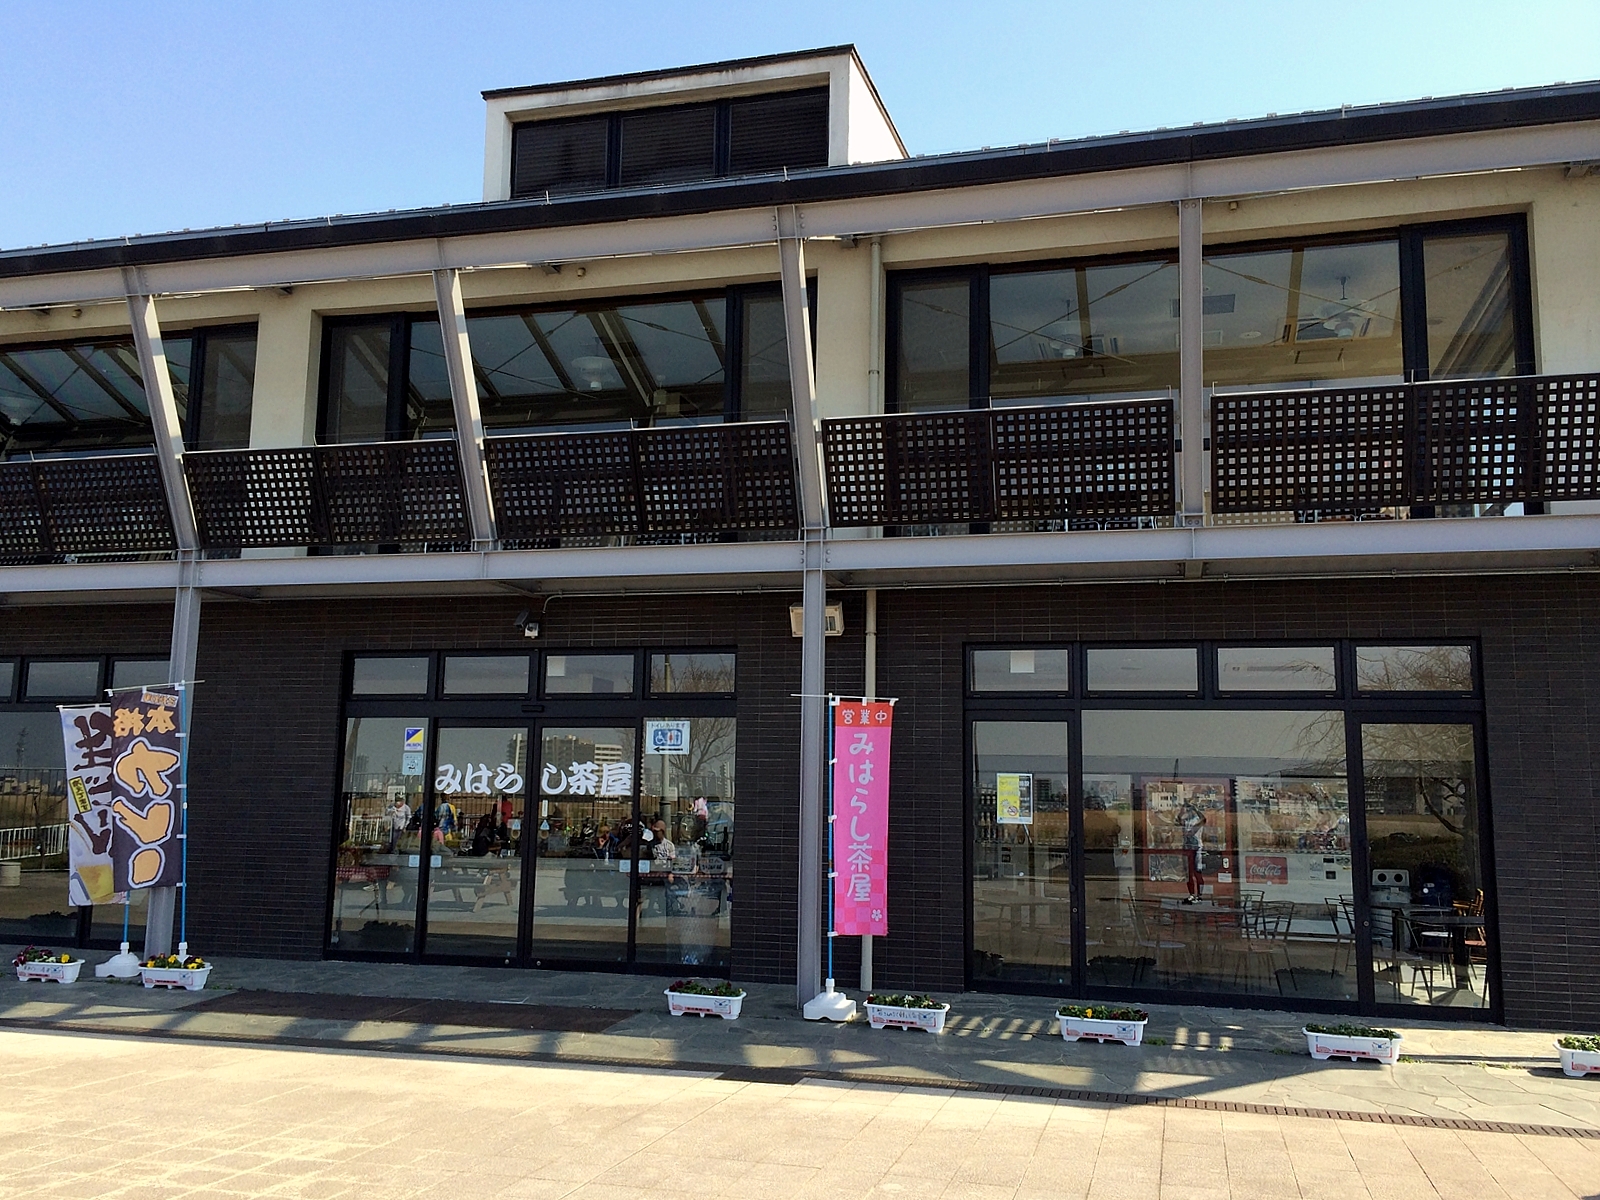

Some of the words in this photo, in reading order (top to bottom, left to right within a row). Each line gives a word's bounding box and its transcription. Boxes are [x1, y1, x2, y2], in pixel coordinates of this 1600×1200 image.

[841, 709, 888, 725] 営業中
[847, 733, 875, 902] みはらし茶屋
